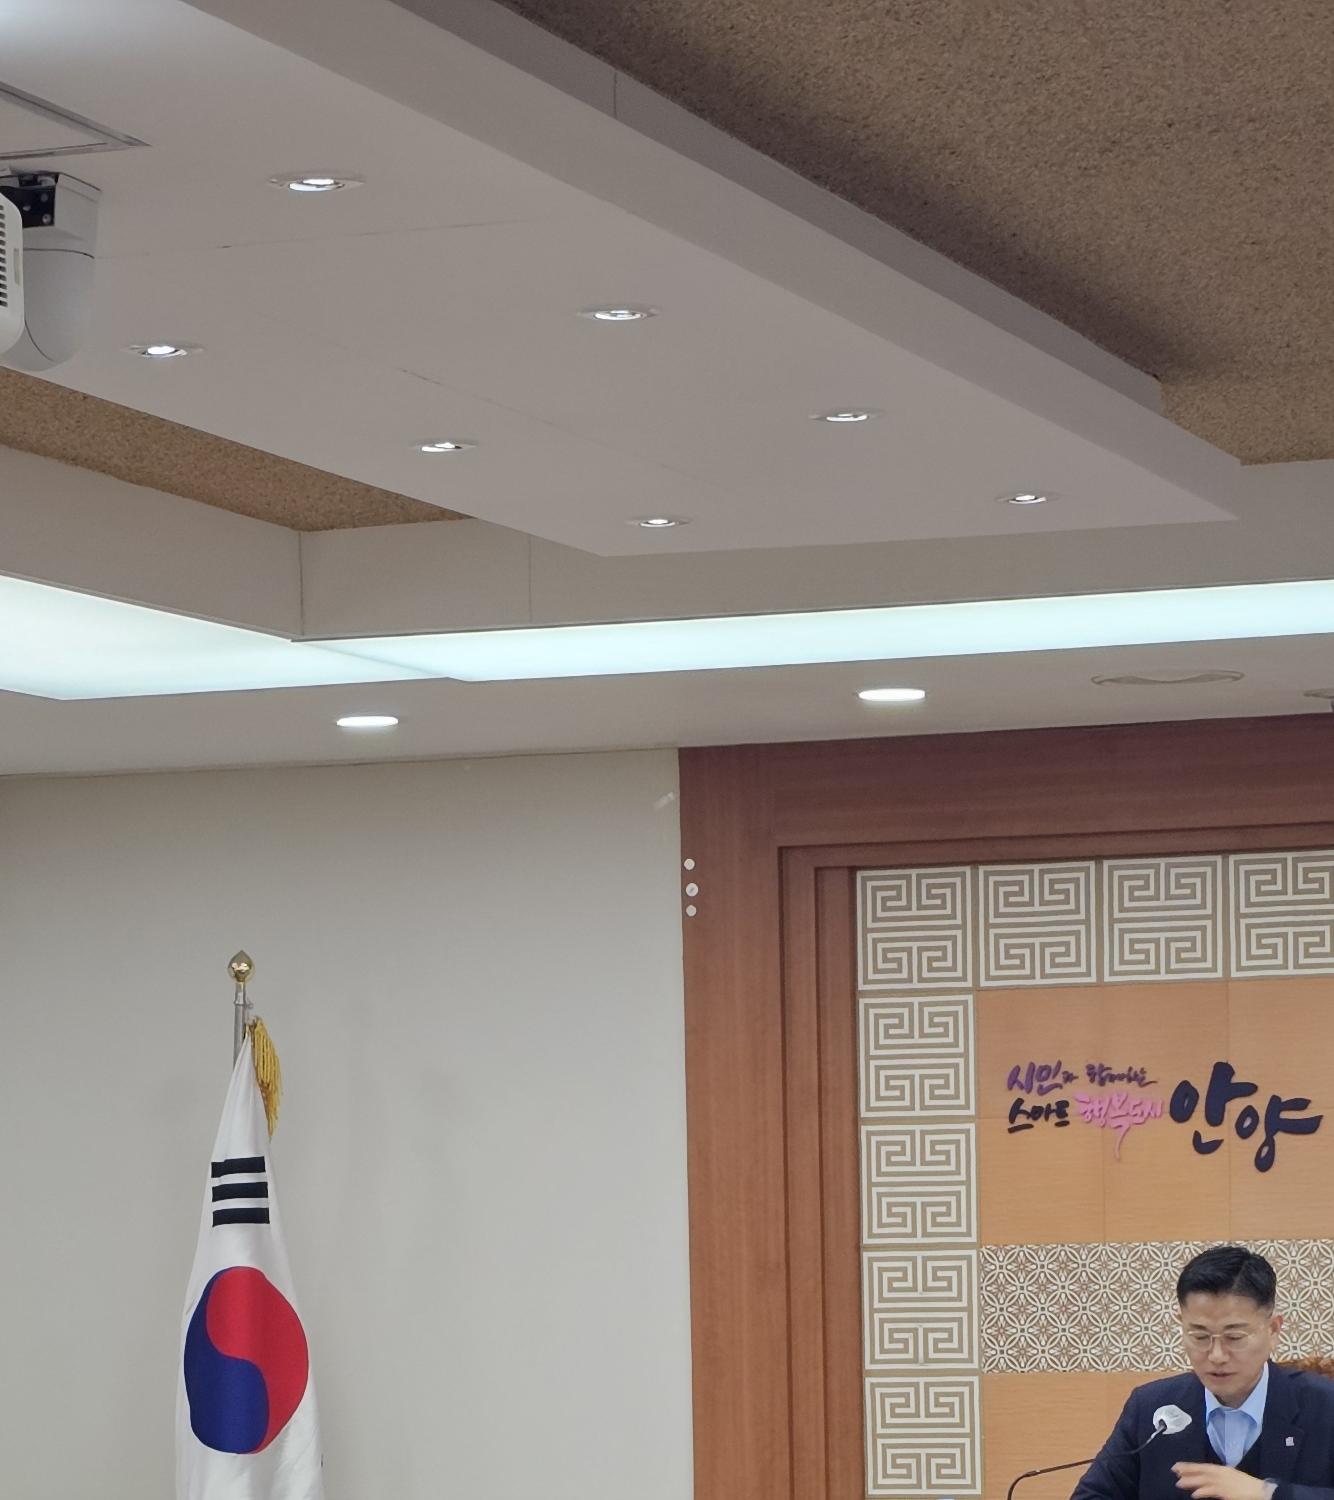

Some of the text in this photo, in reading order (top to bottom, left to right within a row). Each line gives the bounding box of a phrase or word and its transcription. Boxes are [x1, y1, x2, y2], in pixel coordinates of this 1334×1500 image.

[1007, 1060, 1078, 1096] 시민과
[1007, 1091, 1165, 1161] 스마트 행복도시
[1169, 1061, 1324, 1173] 안양
